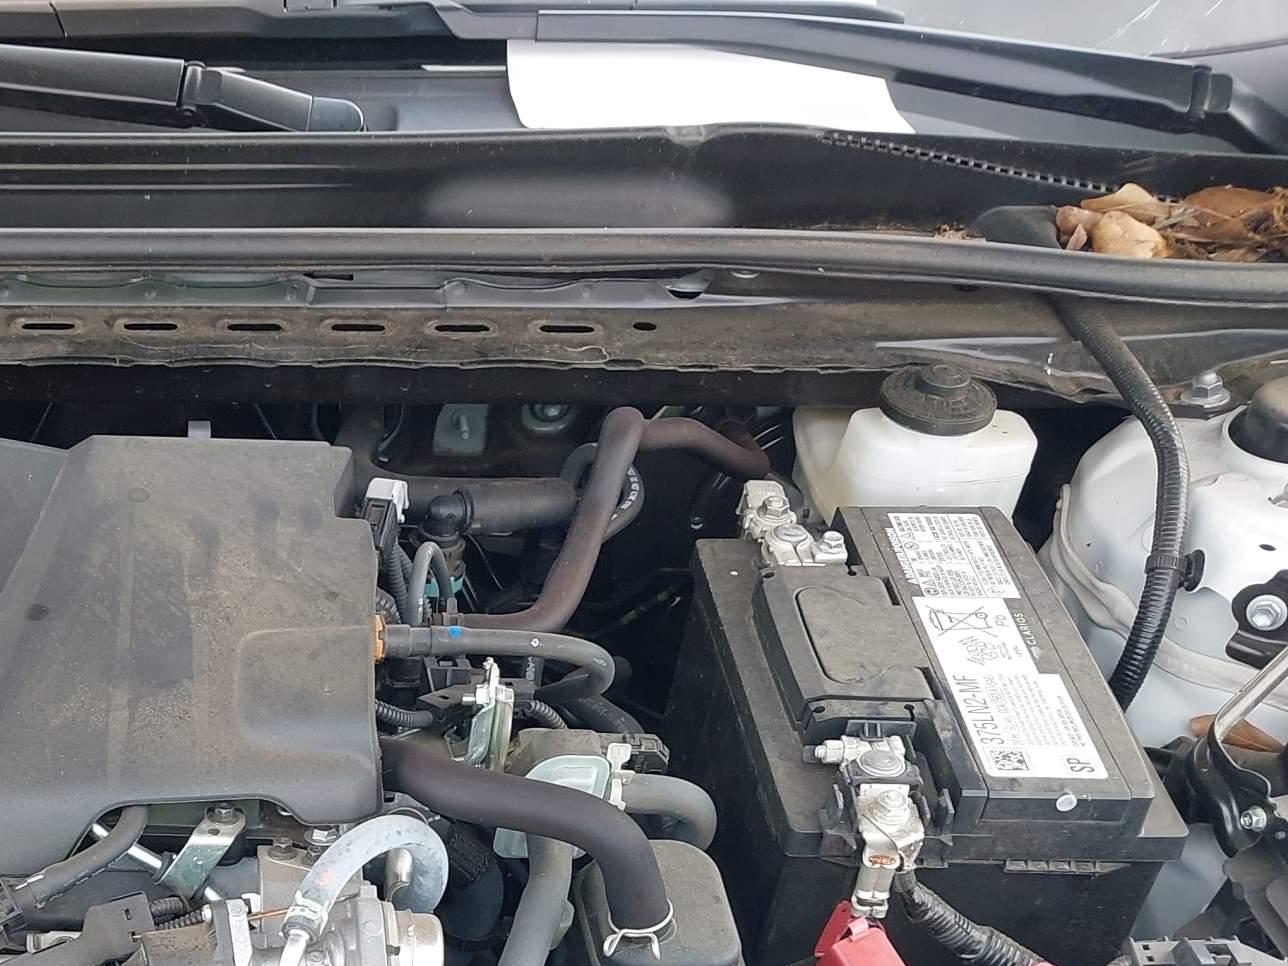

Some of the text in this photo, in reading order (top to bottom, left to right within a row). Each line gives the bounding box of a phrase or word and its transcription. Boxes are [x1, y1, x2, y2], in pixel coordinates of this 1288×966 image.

[1014, 612, 1038, 646] CLARIOS
[952, 675, 1005, 745] 375LN2-MF
[1069, 757, 1096, 774] SP
